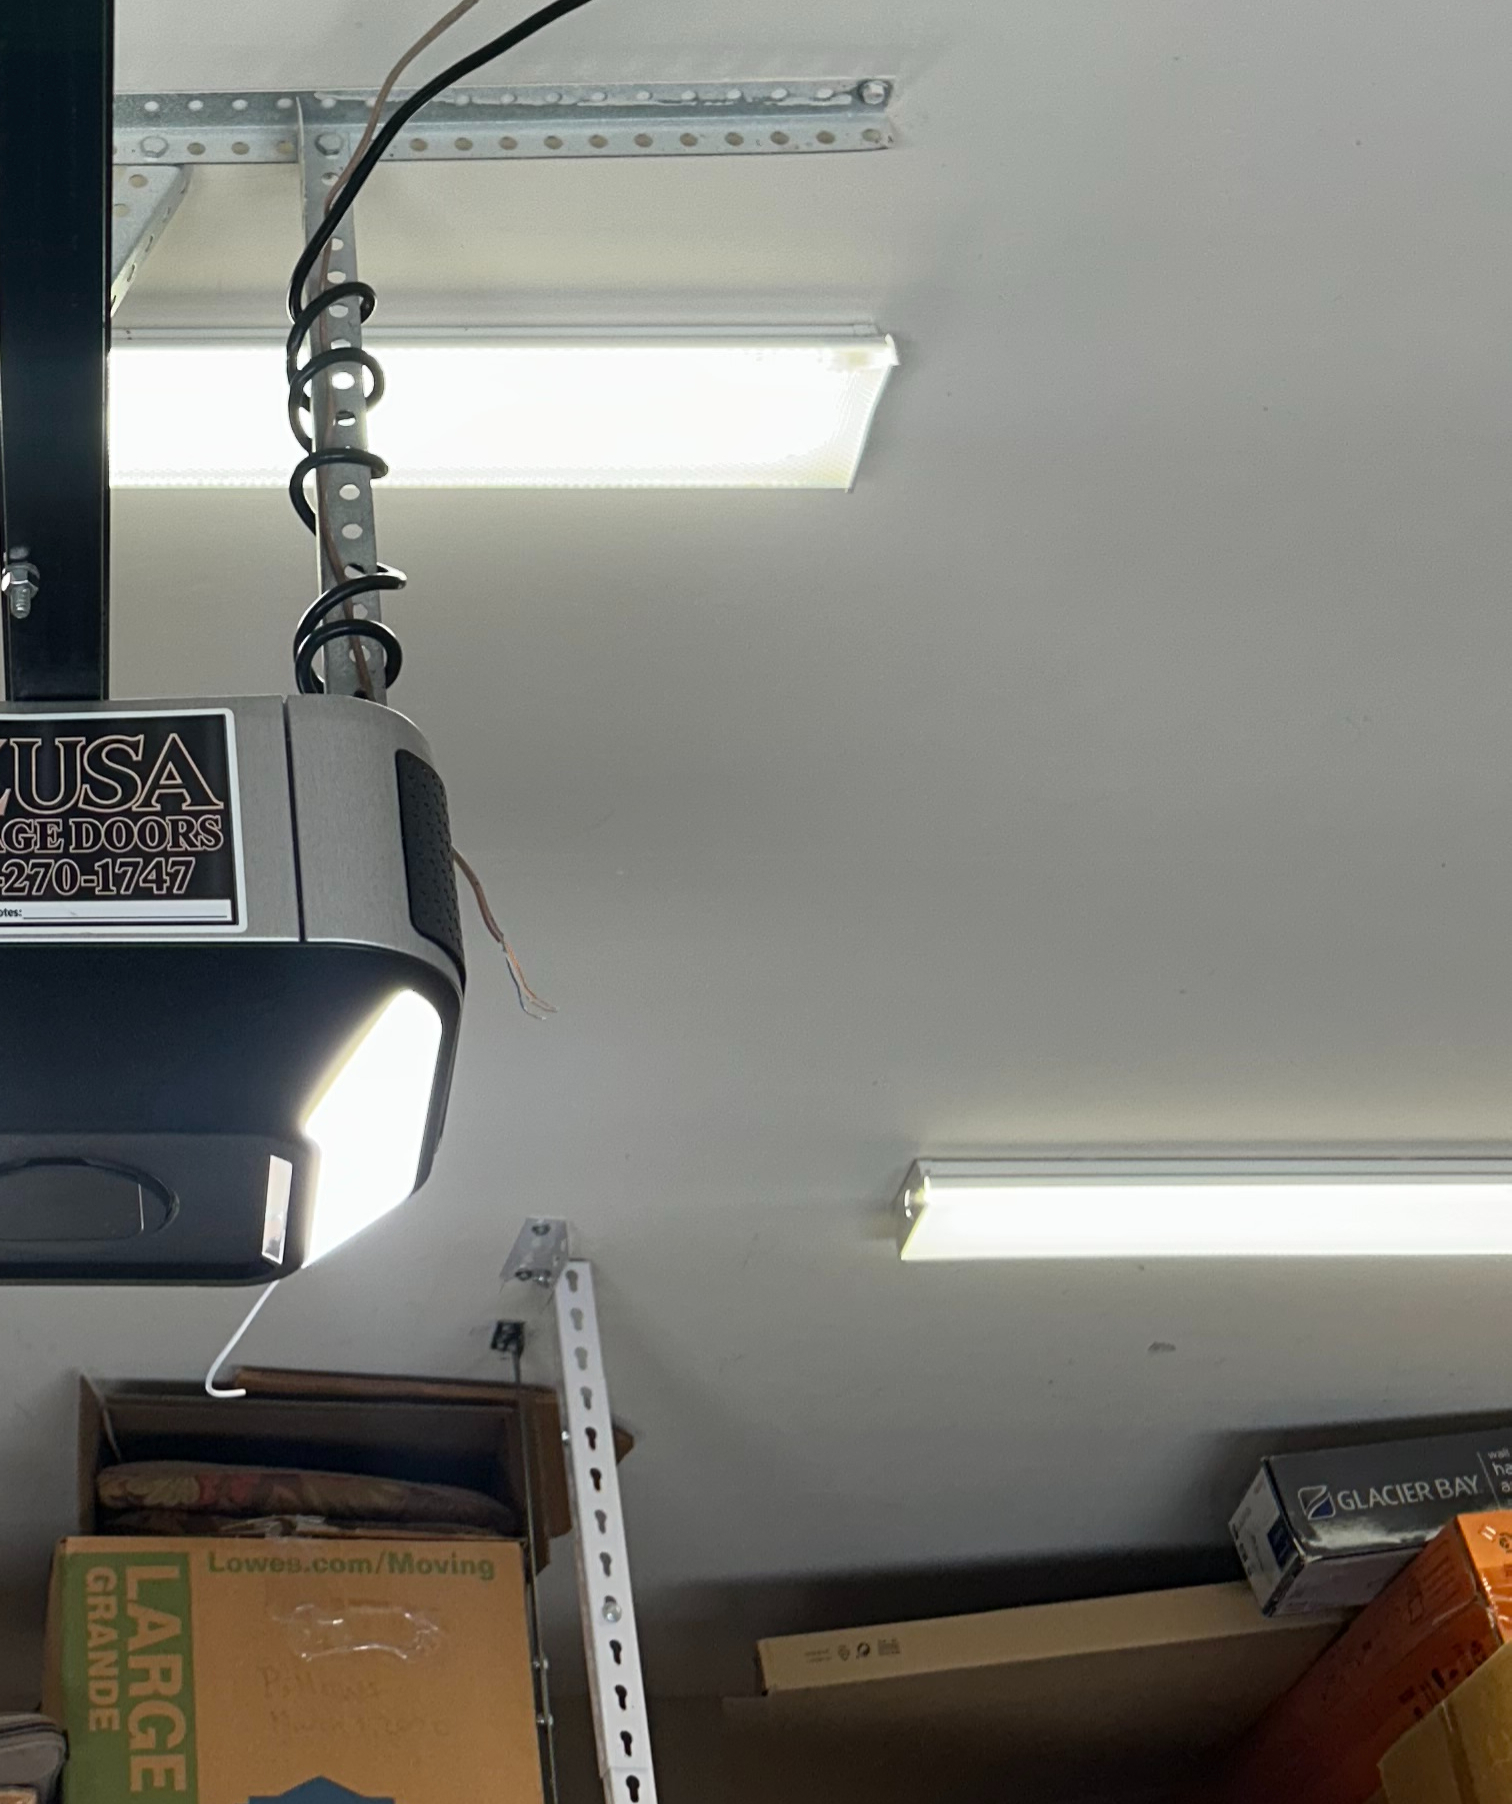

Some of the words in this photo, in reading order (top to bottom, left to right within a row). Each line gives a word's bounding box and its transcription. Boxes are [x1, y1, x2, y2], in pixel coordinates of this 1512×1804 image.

[69, 815, 224, 853] DOORS
[1337, 1480, 1434, 1512] GLACIER
[1435, 1473, 1479, 1500] BAY
[207, 1551, 496, 1581] Lowes.com/Moving
[83, 1566, 121, 1733] GRANDE
[125, 1564, 187, 1794] LARGE
